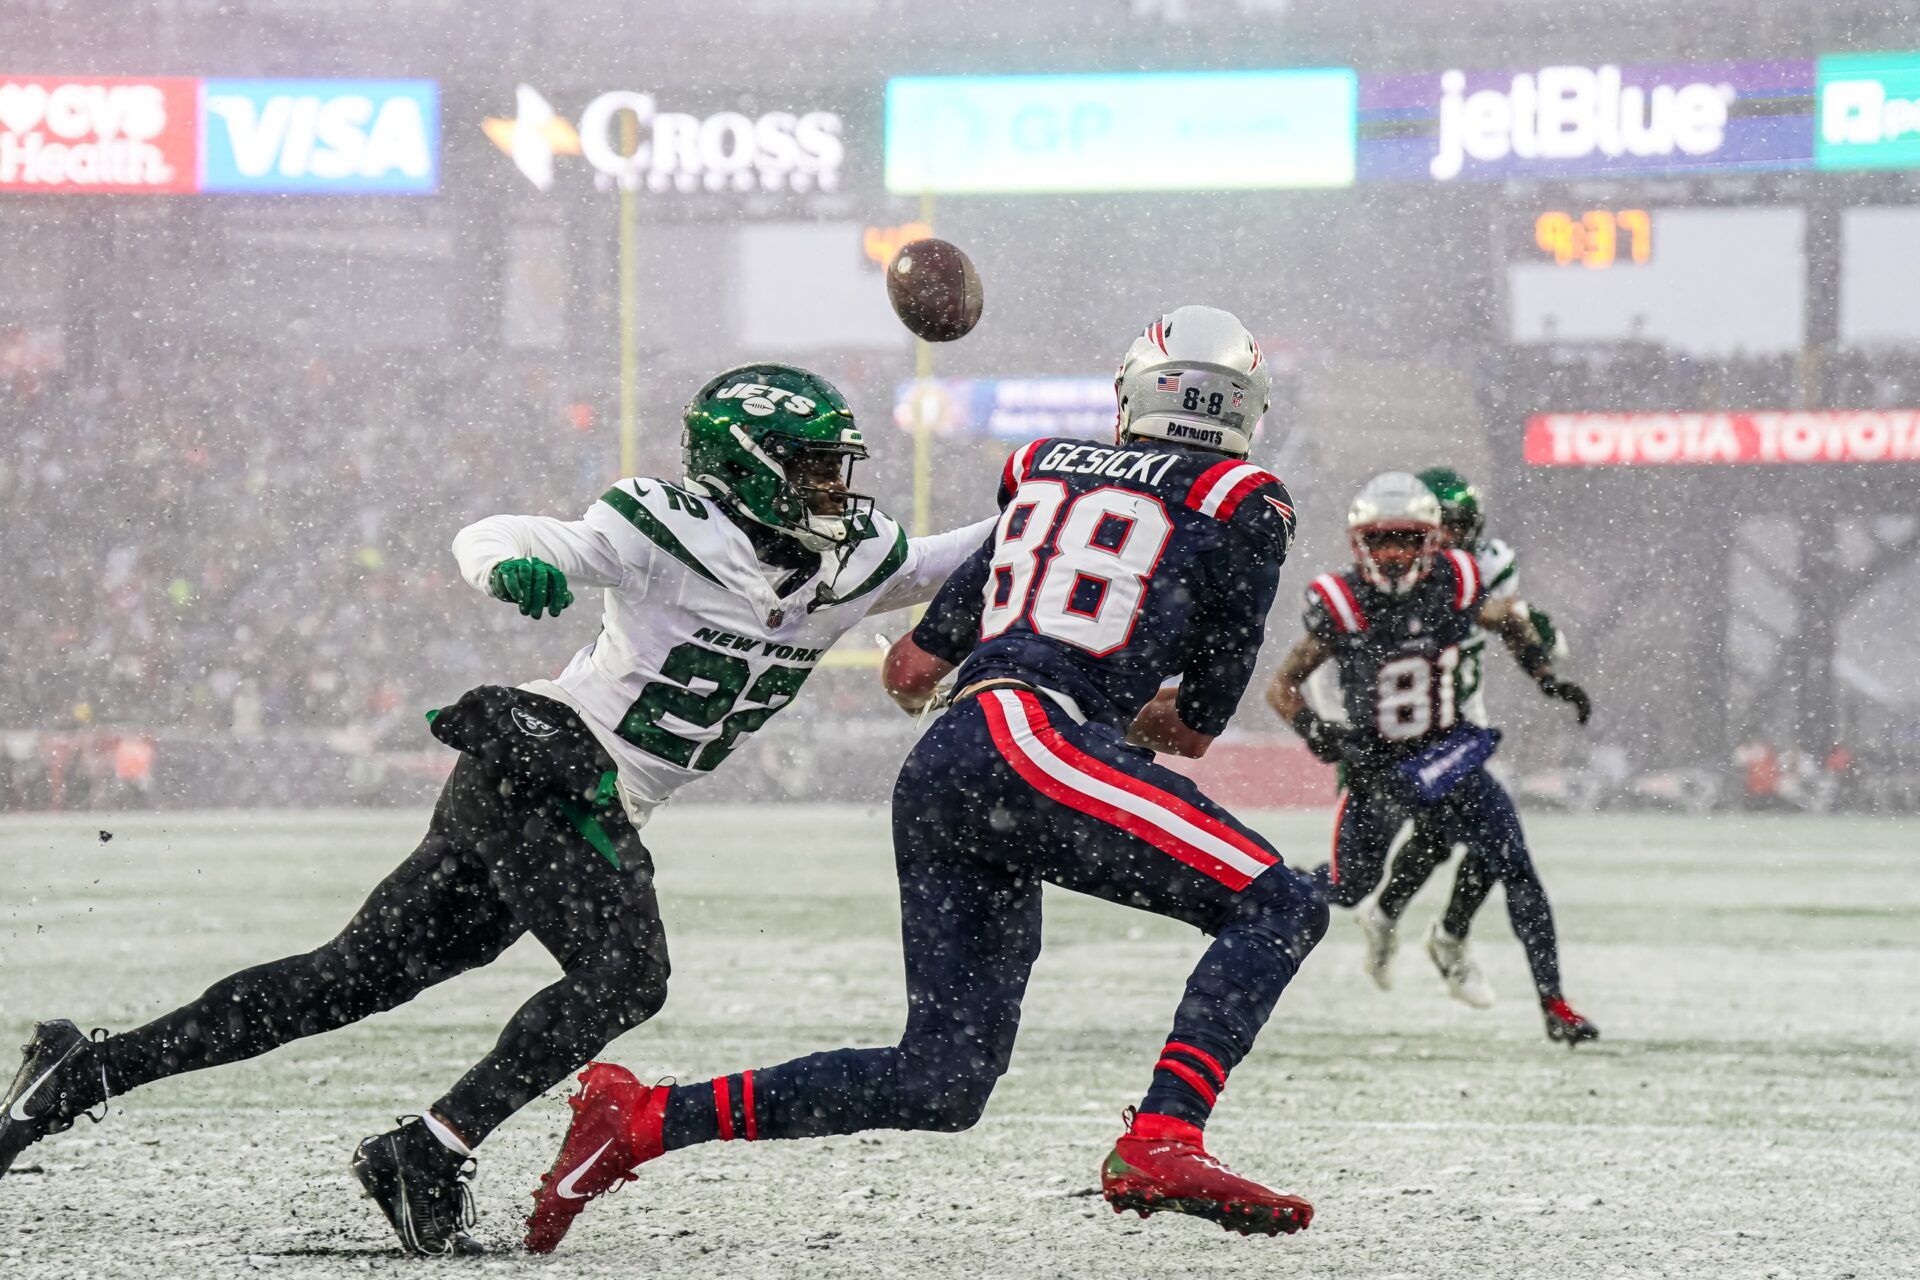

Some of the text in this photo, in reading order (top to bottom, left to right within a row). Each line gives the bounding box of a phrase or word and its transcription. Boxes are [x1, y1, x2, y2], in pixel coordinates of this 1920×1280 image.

[208, 96, 429, 178] VISA
[1430, 64, 1728, 181] jetBlue
[1536, 211, 1650, 267] 9:37
[716, 382, 817, 416] JETS
[1167, 422, 1223, 445] PATRIOTS
[1545, 409, 1920, 464] TOYOTA TOYOT
[1039, 443, 1180, 486] GESICKI
[981, 479, 1175, 658] 88
[692, 627, 824, 662] NEW YORK
[613, 641, 813, 771] 22
[1377, 644, 1459, 741] 81
